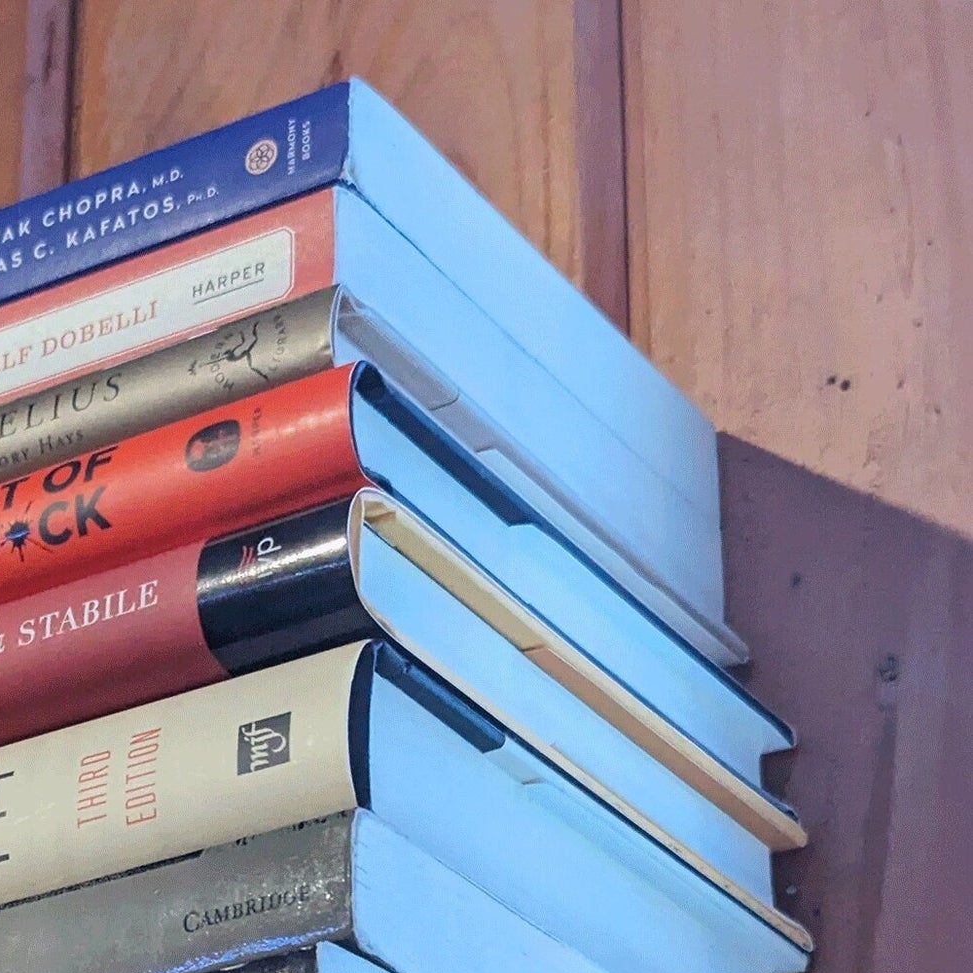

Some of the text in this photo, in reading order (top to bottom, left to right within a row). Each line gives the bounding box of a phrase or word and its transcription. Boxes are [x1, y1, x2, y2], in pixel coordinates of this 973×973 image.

[301, 119, 312, 161] BOOKS
[42, 180, 147, 229] CHOPRA,
[151, 168, 185, 190] M.D.
[34, 243, 54, 261] C.
[66, 196, 181, 250] KAFATOS,
[191, 259, 267, 299] HARPER
[40, 300, 159, 358] DOBELLI
[39, 427, 86, 456] HAYS
[42, 444, 122, 491] OF
[16, 579, 160, 648] STABILE
[76, 749, 112, 830] THIRD
[124, 726, 163, 827] EDITION
[182, 884, 311, 934] CAMBRIDGE
